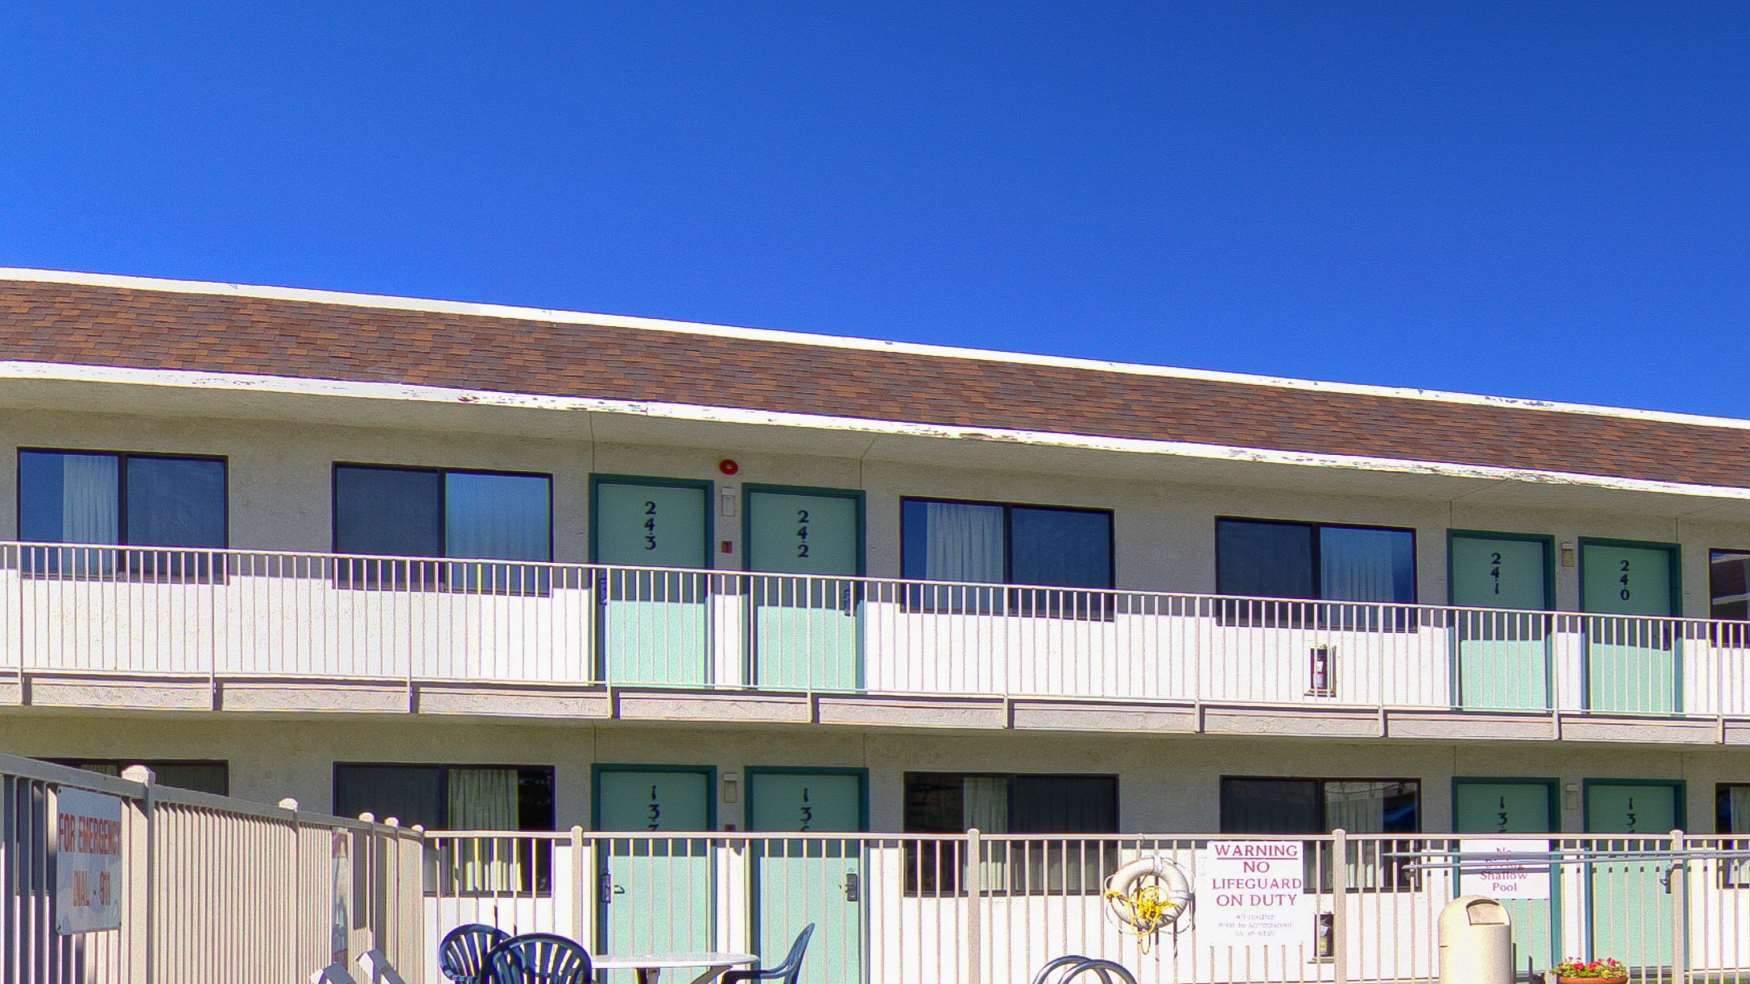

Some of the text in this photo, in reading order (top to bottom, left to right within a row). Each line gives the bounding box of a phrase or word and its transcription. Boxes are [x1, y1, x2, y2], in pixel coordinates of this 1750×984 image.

[644, 501, 657, 551] 243
[797, 510, 810, 559] 242
[1490, 552, 1501, 595] 241
[1620, 559, 1631, 601] 240
[58, 813, 76, 853] FOR
[1498, 796, 1508, 834] 13
[1626, 797, 1637, 834] 13
[1214, 844, 1298, 857] WARNING
[1243, 861, 1270, 874] NO
[1212, 878, 1302, 890] LIFEGUARD
[1216, 894, 1298, 907] ON DUTY
[1492, 882, 1518, 892] Pool
